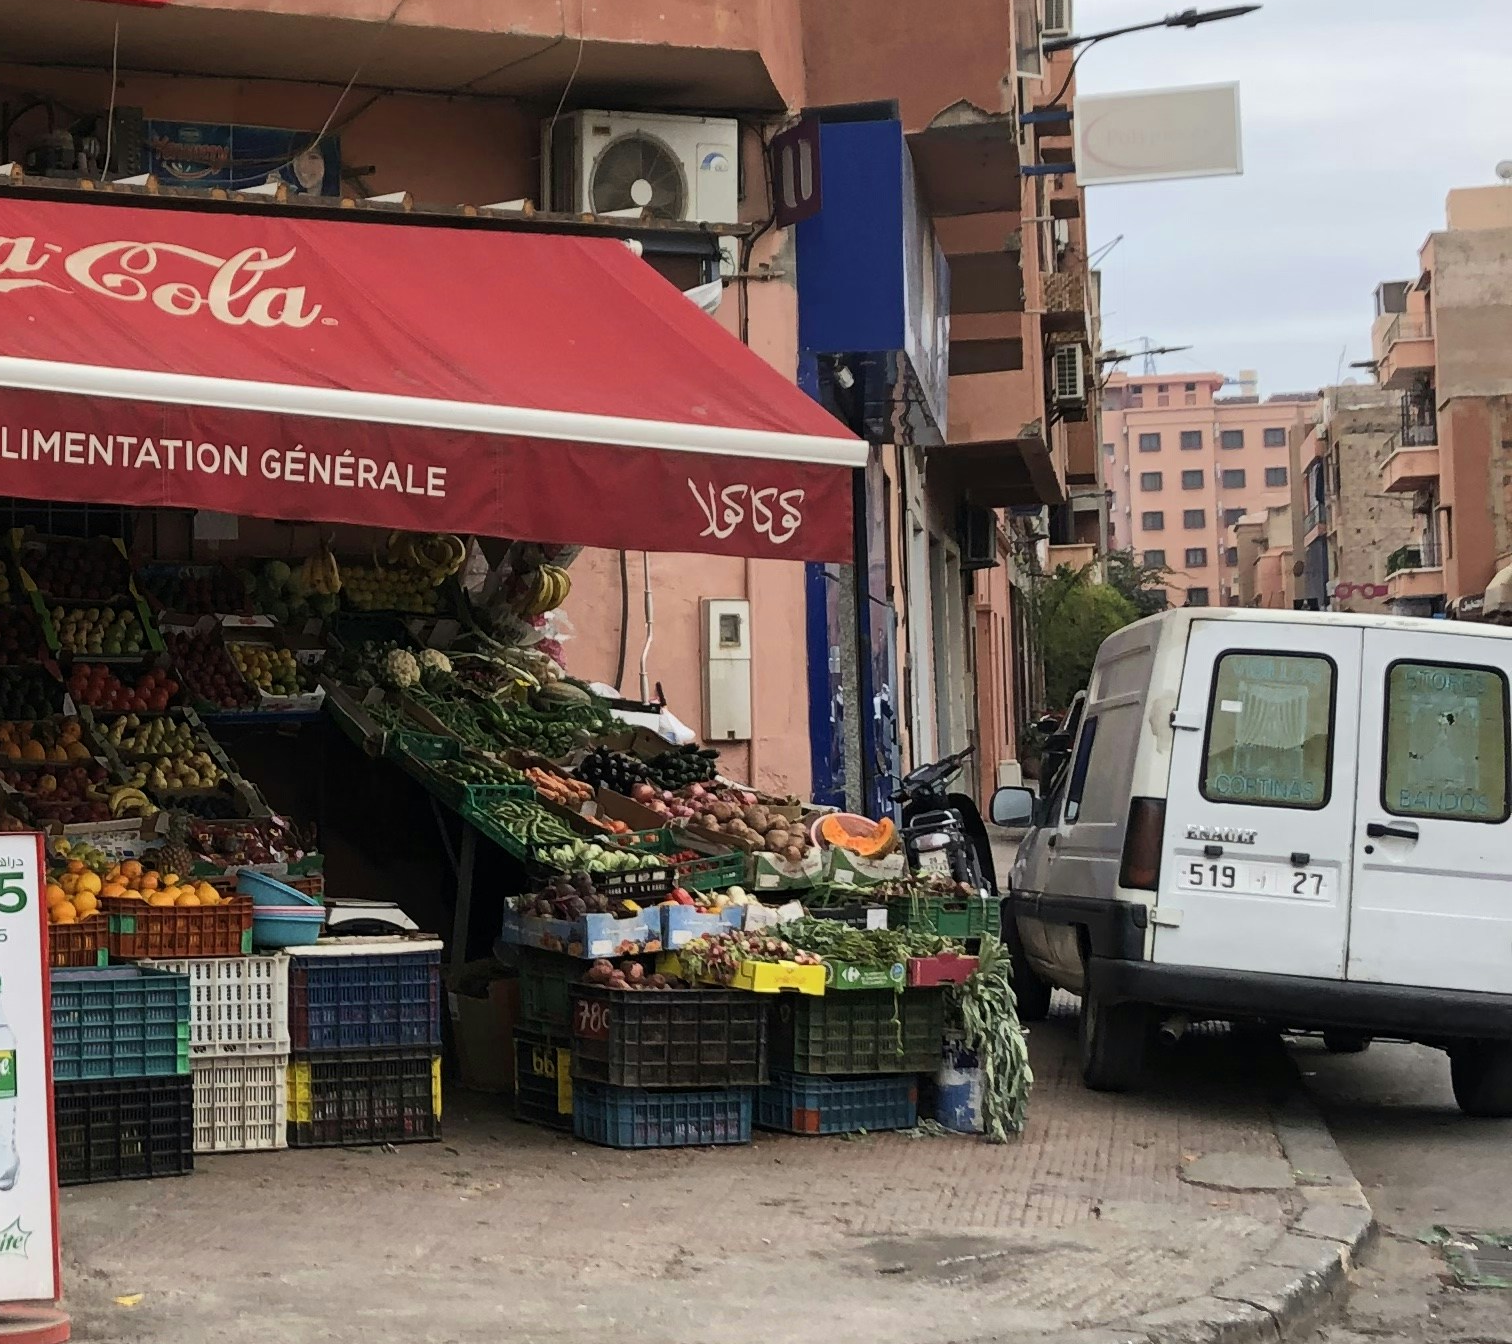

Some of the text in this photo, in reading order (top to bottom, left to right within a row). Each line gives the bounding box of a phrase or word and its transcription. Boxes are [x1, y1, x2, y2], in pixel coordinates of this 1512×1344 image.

[260, 442, 448, 498] GÉNÉRALE
[1190, 863, 1235, 888] 519
[1293, 871, 1323, 895] 27
